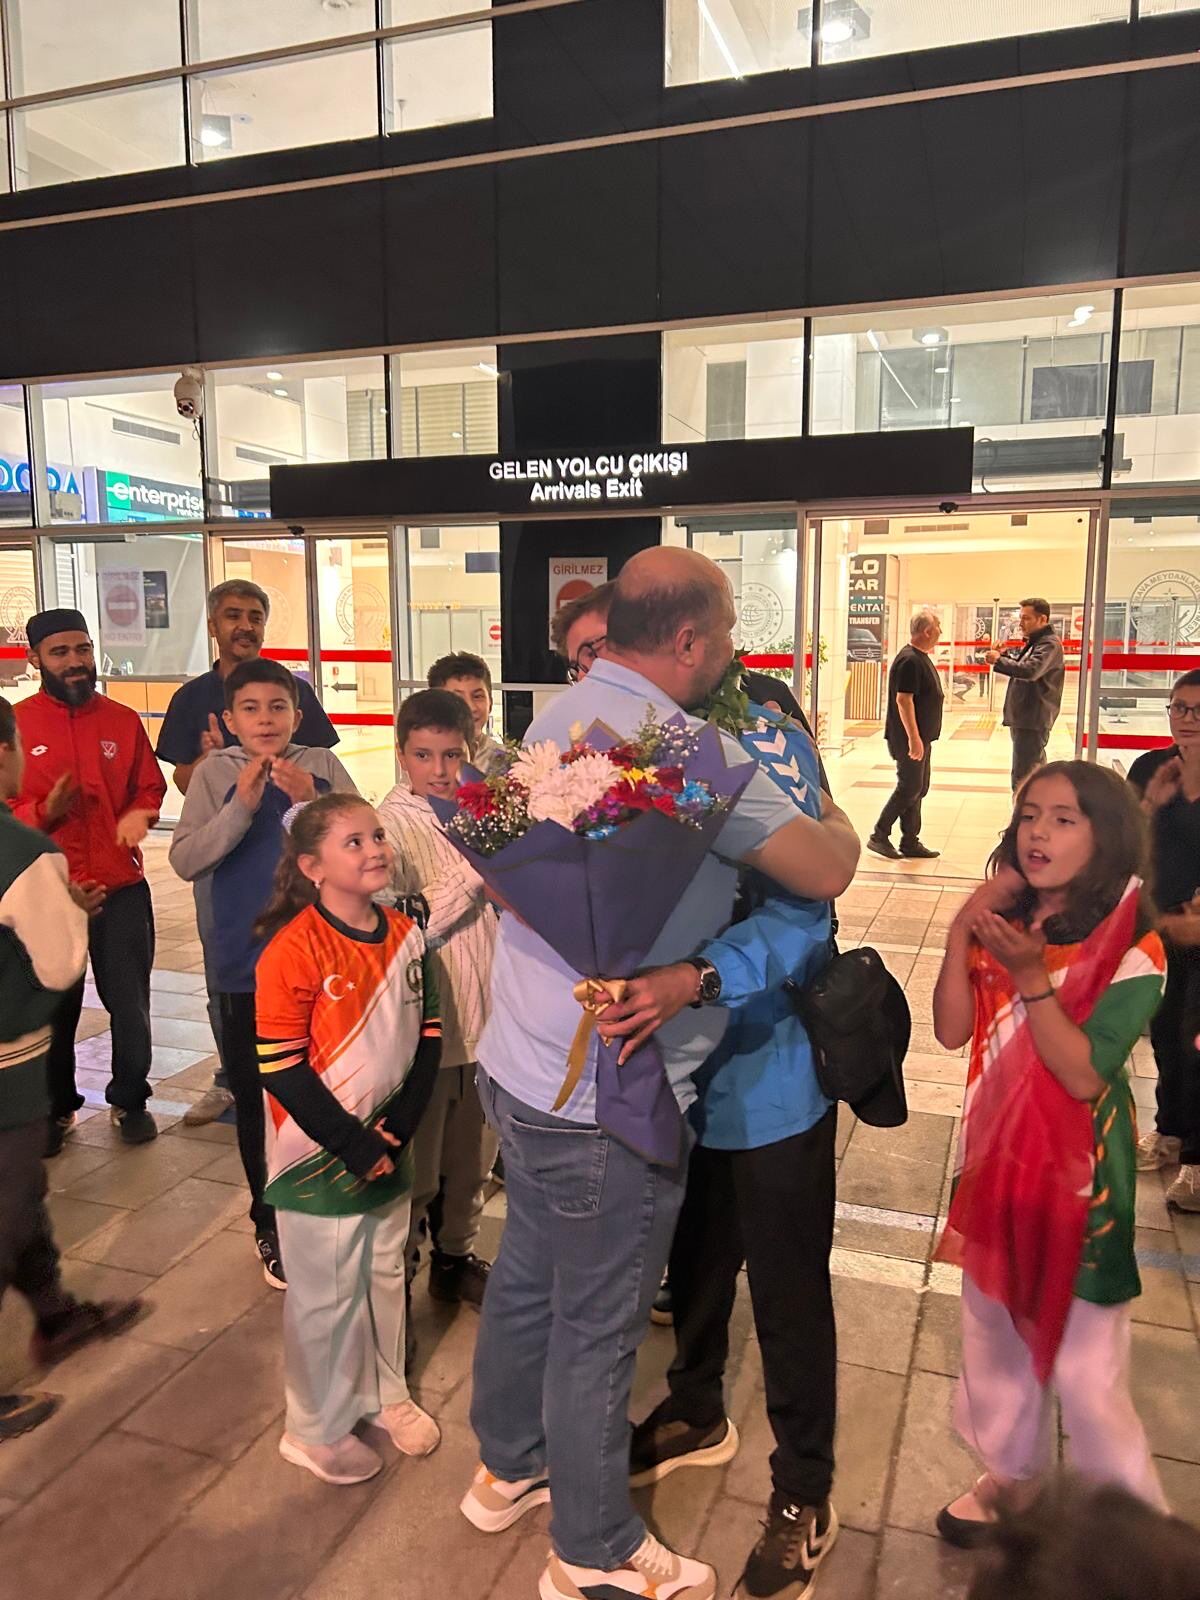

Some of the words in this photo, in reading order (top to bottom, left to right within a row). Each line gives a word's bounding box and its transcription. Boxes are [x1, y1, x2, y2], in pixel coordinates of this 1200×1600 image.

[489, 459, 553, 479] GELEN
[556, 453, 624, 477] YOLCU
[629, 452, 688, 477] ÇIKIŞI
[530, 481, 601, 501] Arrivals
[606, 478, 643, 498] Exit
[553, 564, 604, 575] GİRİLMEZ
